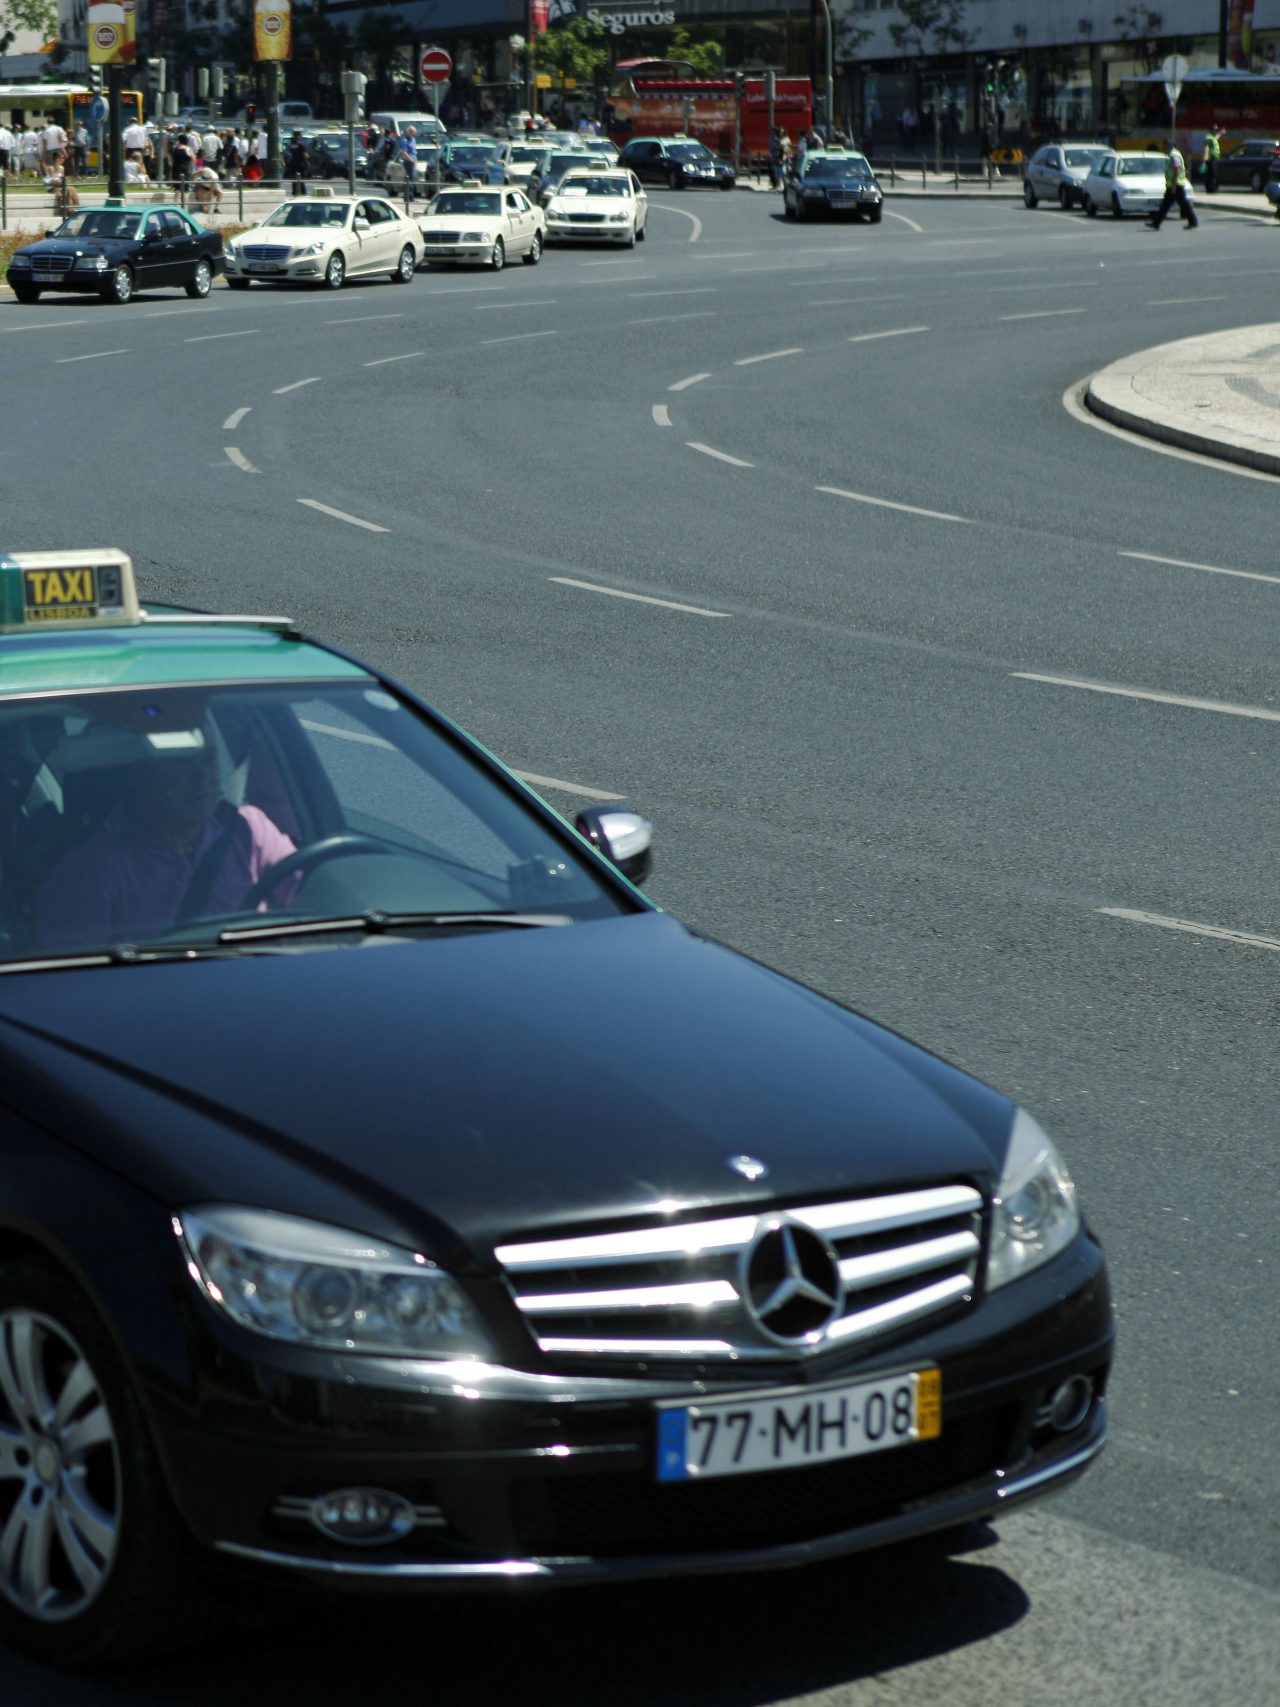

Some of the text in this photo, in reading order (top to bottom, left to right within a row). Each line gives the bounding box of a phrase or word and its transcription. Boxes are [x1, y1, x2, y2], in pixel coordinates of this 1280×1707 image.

[586, 9, 675, 34] Seguros
[26, 570, 93, 605] TAXI
[28, 608, 89, 620] LISBOA
